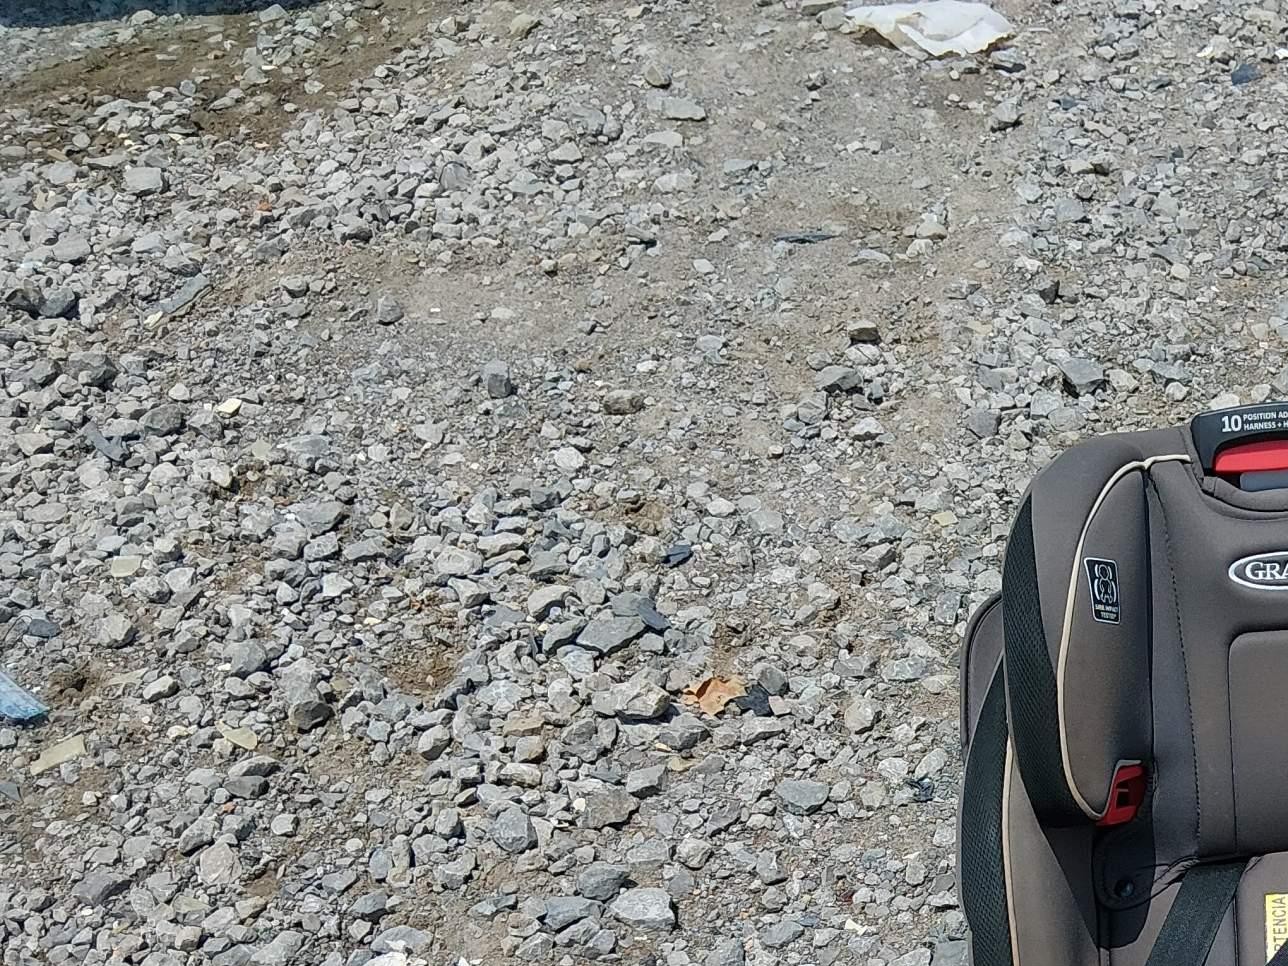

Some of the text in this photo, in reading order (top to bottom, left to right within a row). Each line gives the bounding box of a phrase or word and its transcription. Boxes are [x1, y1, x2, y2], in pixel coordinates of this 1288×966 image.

[1243, 411, 1277, 421] POSITION
[1221, 415, 1242, 432] 10
[1244, 421, 1276, 431] HARNESS
